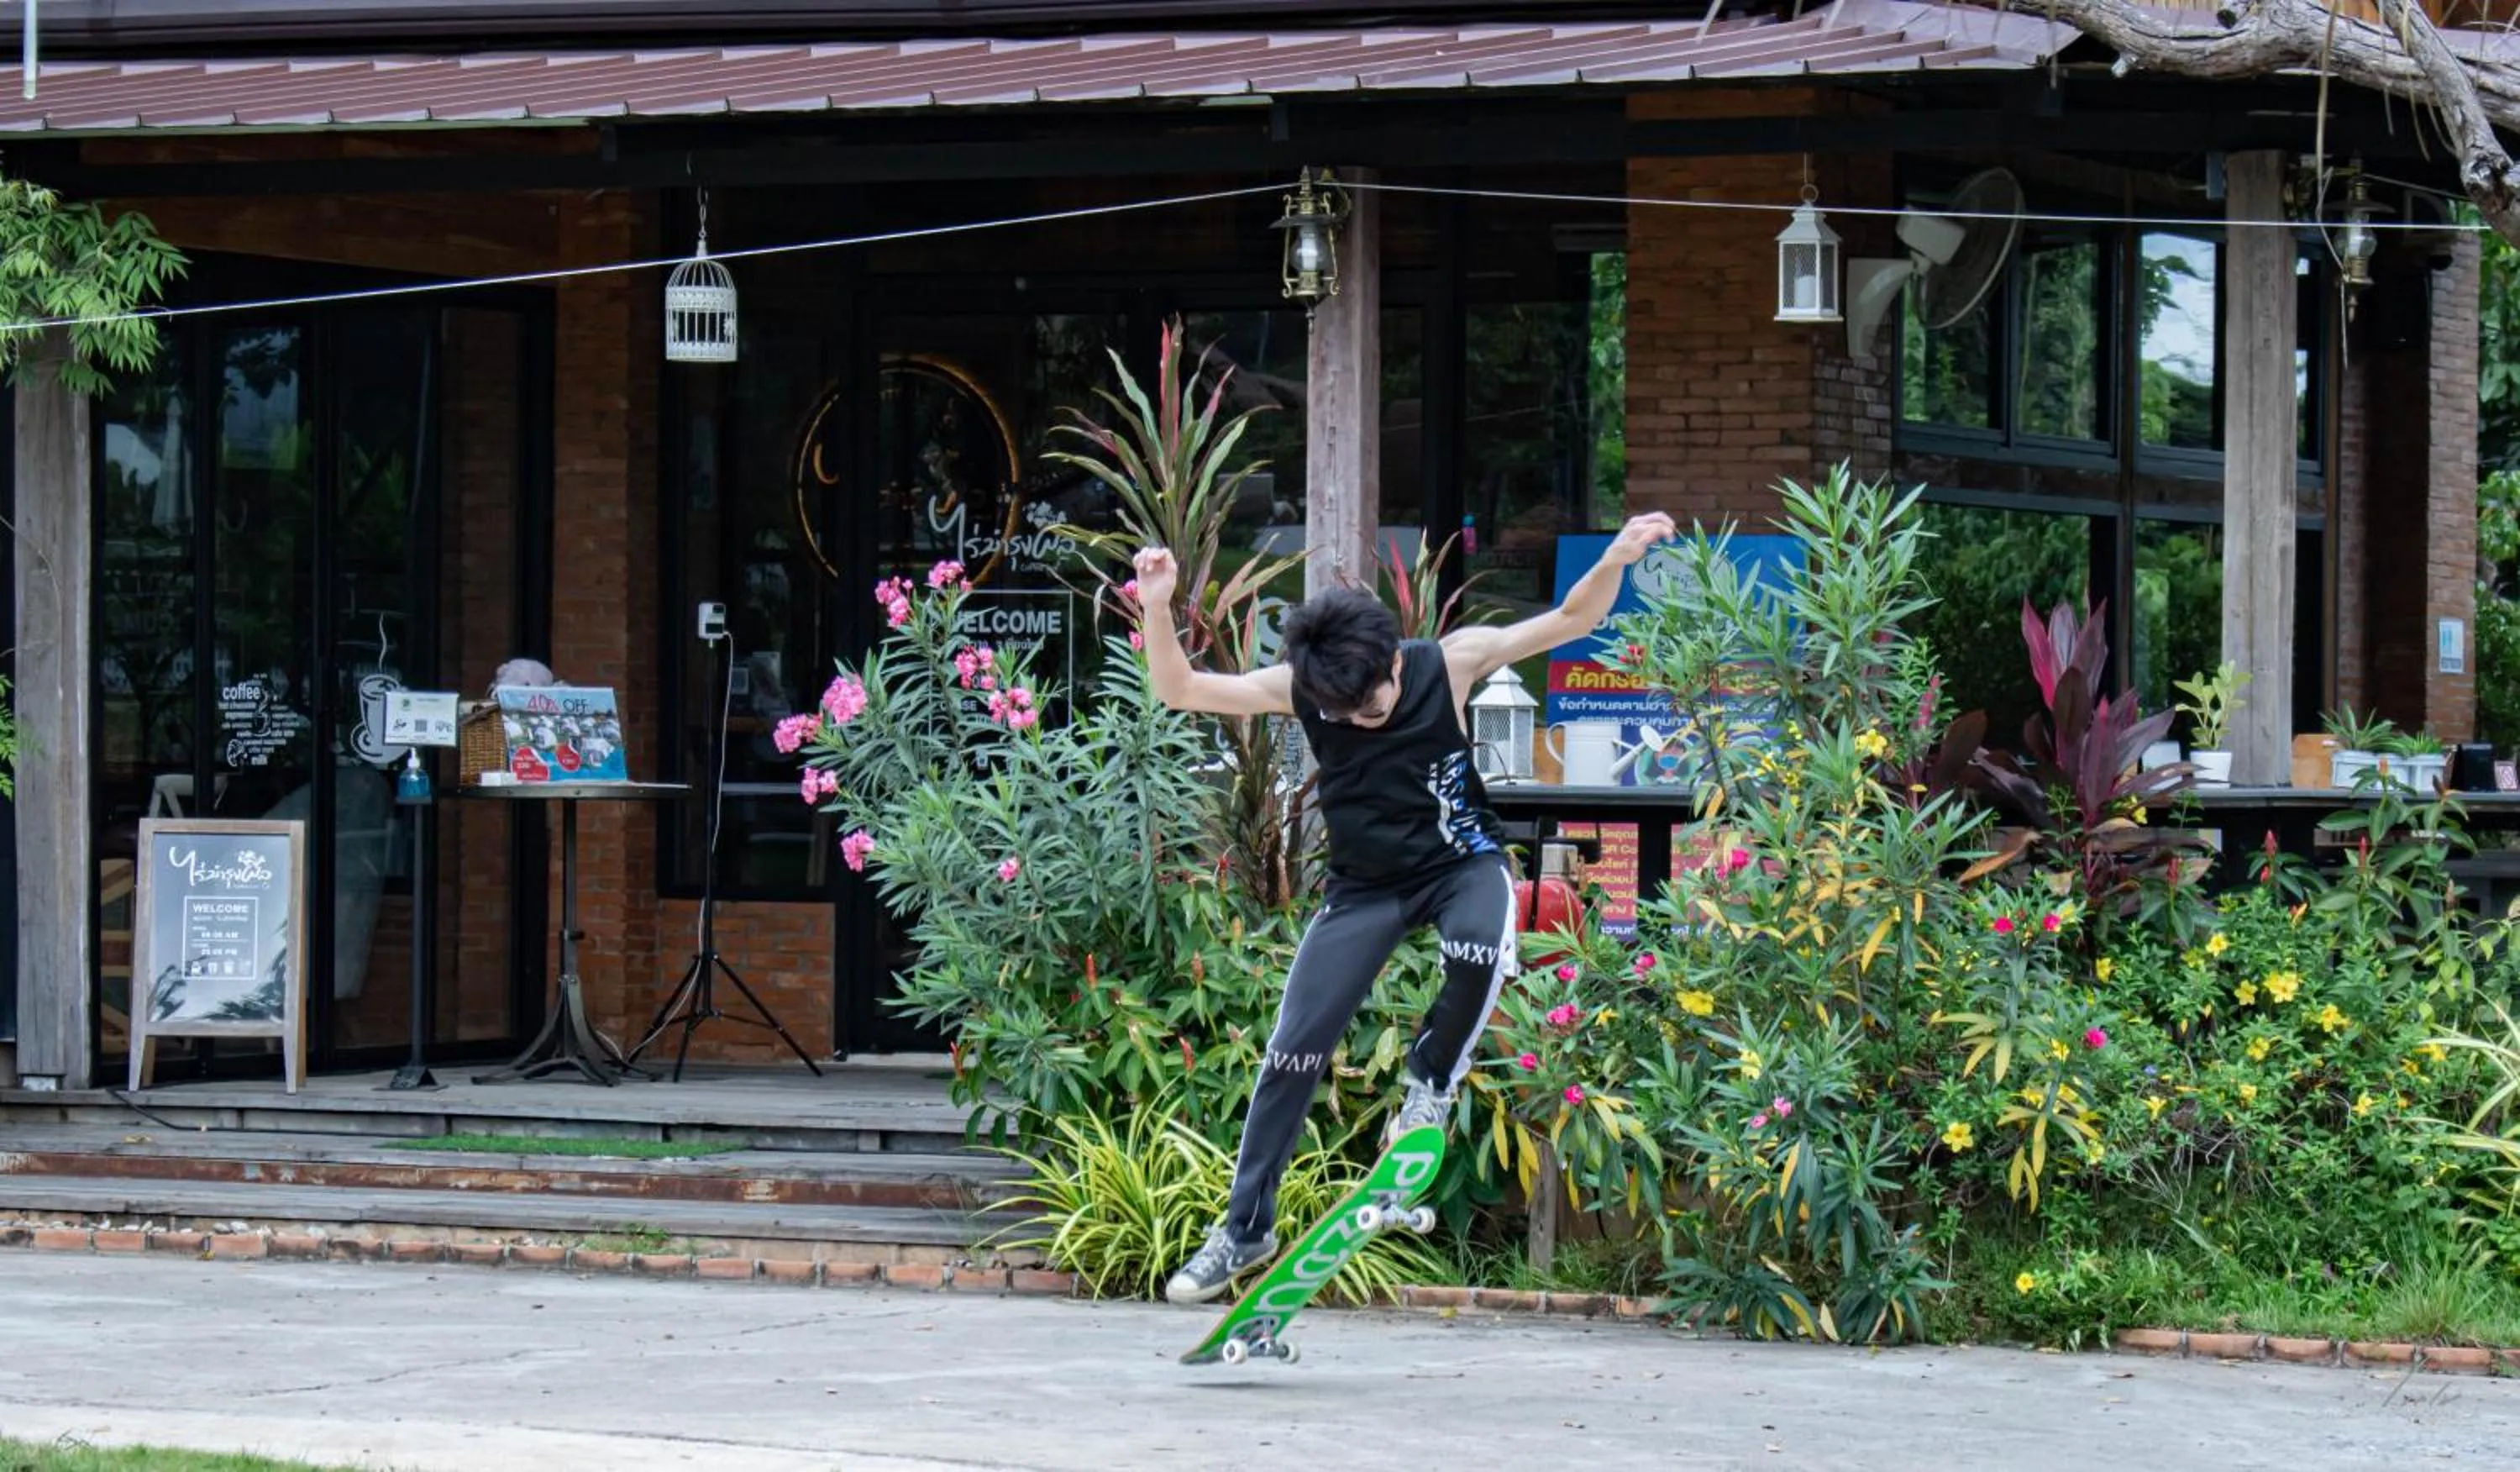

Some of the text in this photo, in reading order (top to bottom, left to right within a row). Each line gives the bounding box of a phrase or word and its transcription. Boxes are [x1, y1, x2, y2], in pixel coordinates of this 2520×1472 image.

[223, 682, 260, 700] coffee
[563, 698, 589, 714] OFF
[192, 903, 249, 913] WELCOME
